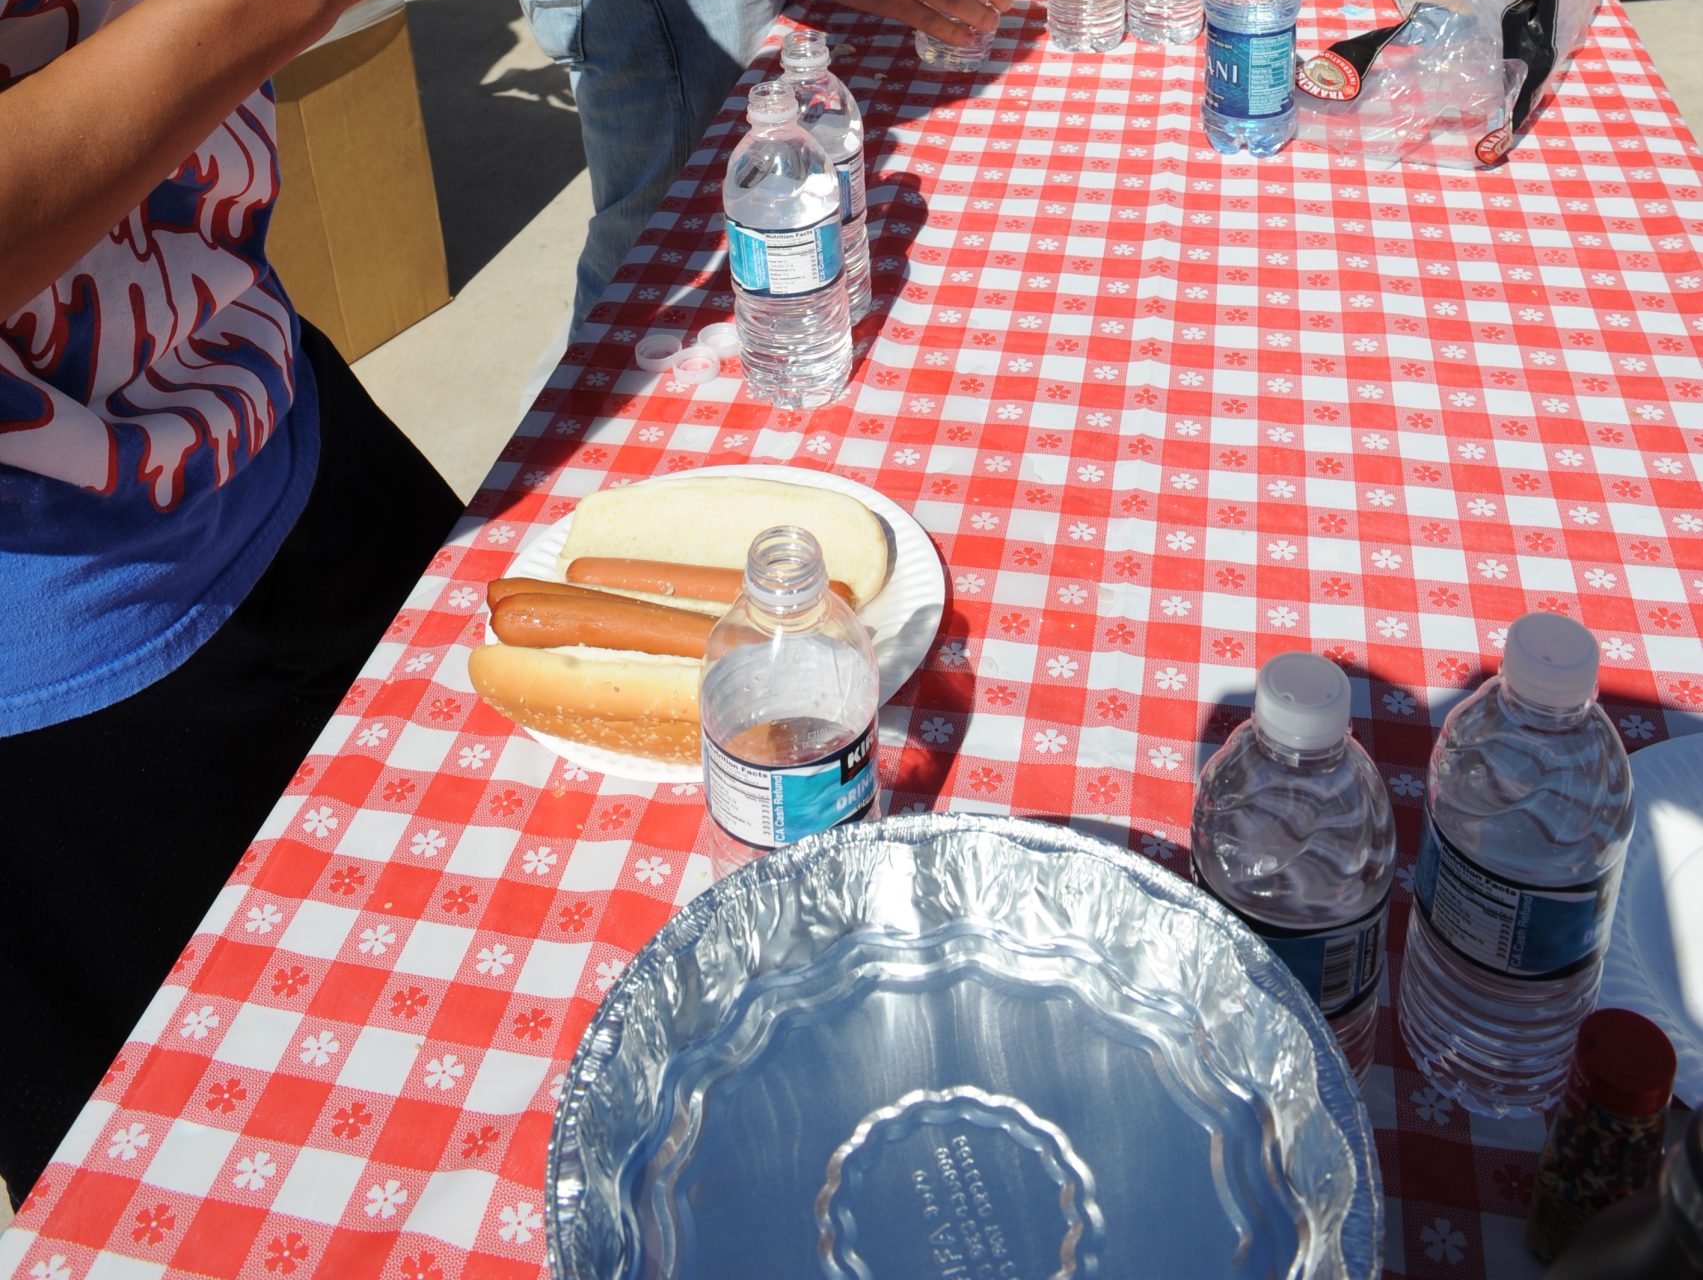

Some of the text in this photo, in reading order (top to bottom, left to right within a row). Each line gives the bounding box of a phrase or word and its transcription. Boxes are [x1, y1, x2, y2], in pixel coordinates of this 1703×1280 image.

[1298, 72, 1345, 100] FRANCIS
[766, 229, 814, 240] Nutrition Facts
[817, 253, 825, 270] Cash
[819, 271, 826, 281] CA
[707, 742, 768, 779] Nutrition Facts
[772, 775, 786, 842] CA Cash Refund
[1442, 844, 1518, 897] Nutrition Facts
[1510, 894, 1534, 968] CA Cash Refund
